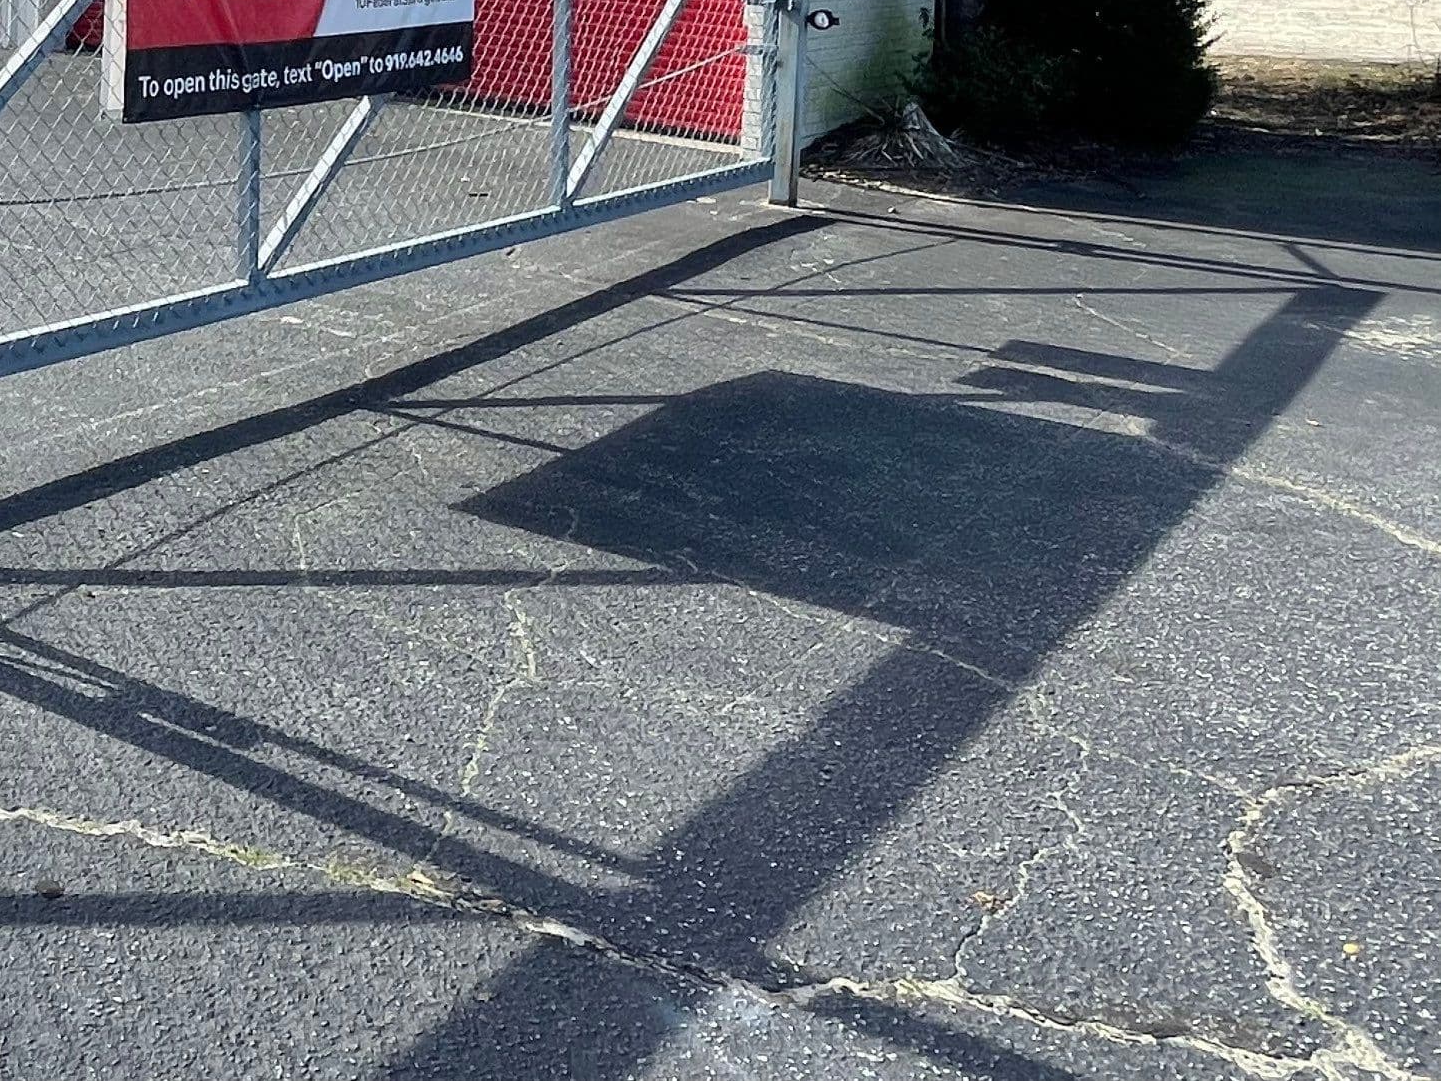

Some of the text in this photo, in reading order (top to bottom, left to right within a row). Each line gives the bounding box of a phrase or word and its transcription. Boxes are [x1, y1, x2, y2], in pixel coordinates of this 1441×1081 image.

[138, 75, 159, 99] To
[163, 74, 206, 100] open
[209, 68, 240, 92] this
[242, 68, 281, 94] gate,
[284, 63, 313, 86] text
[369, 56, 384, 74] to
[385, 45, 464, 72] 919.642.4646
